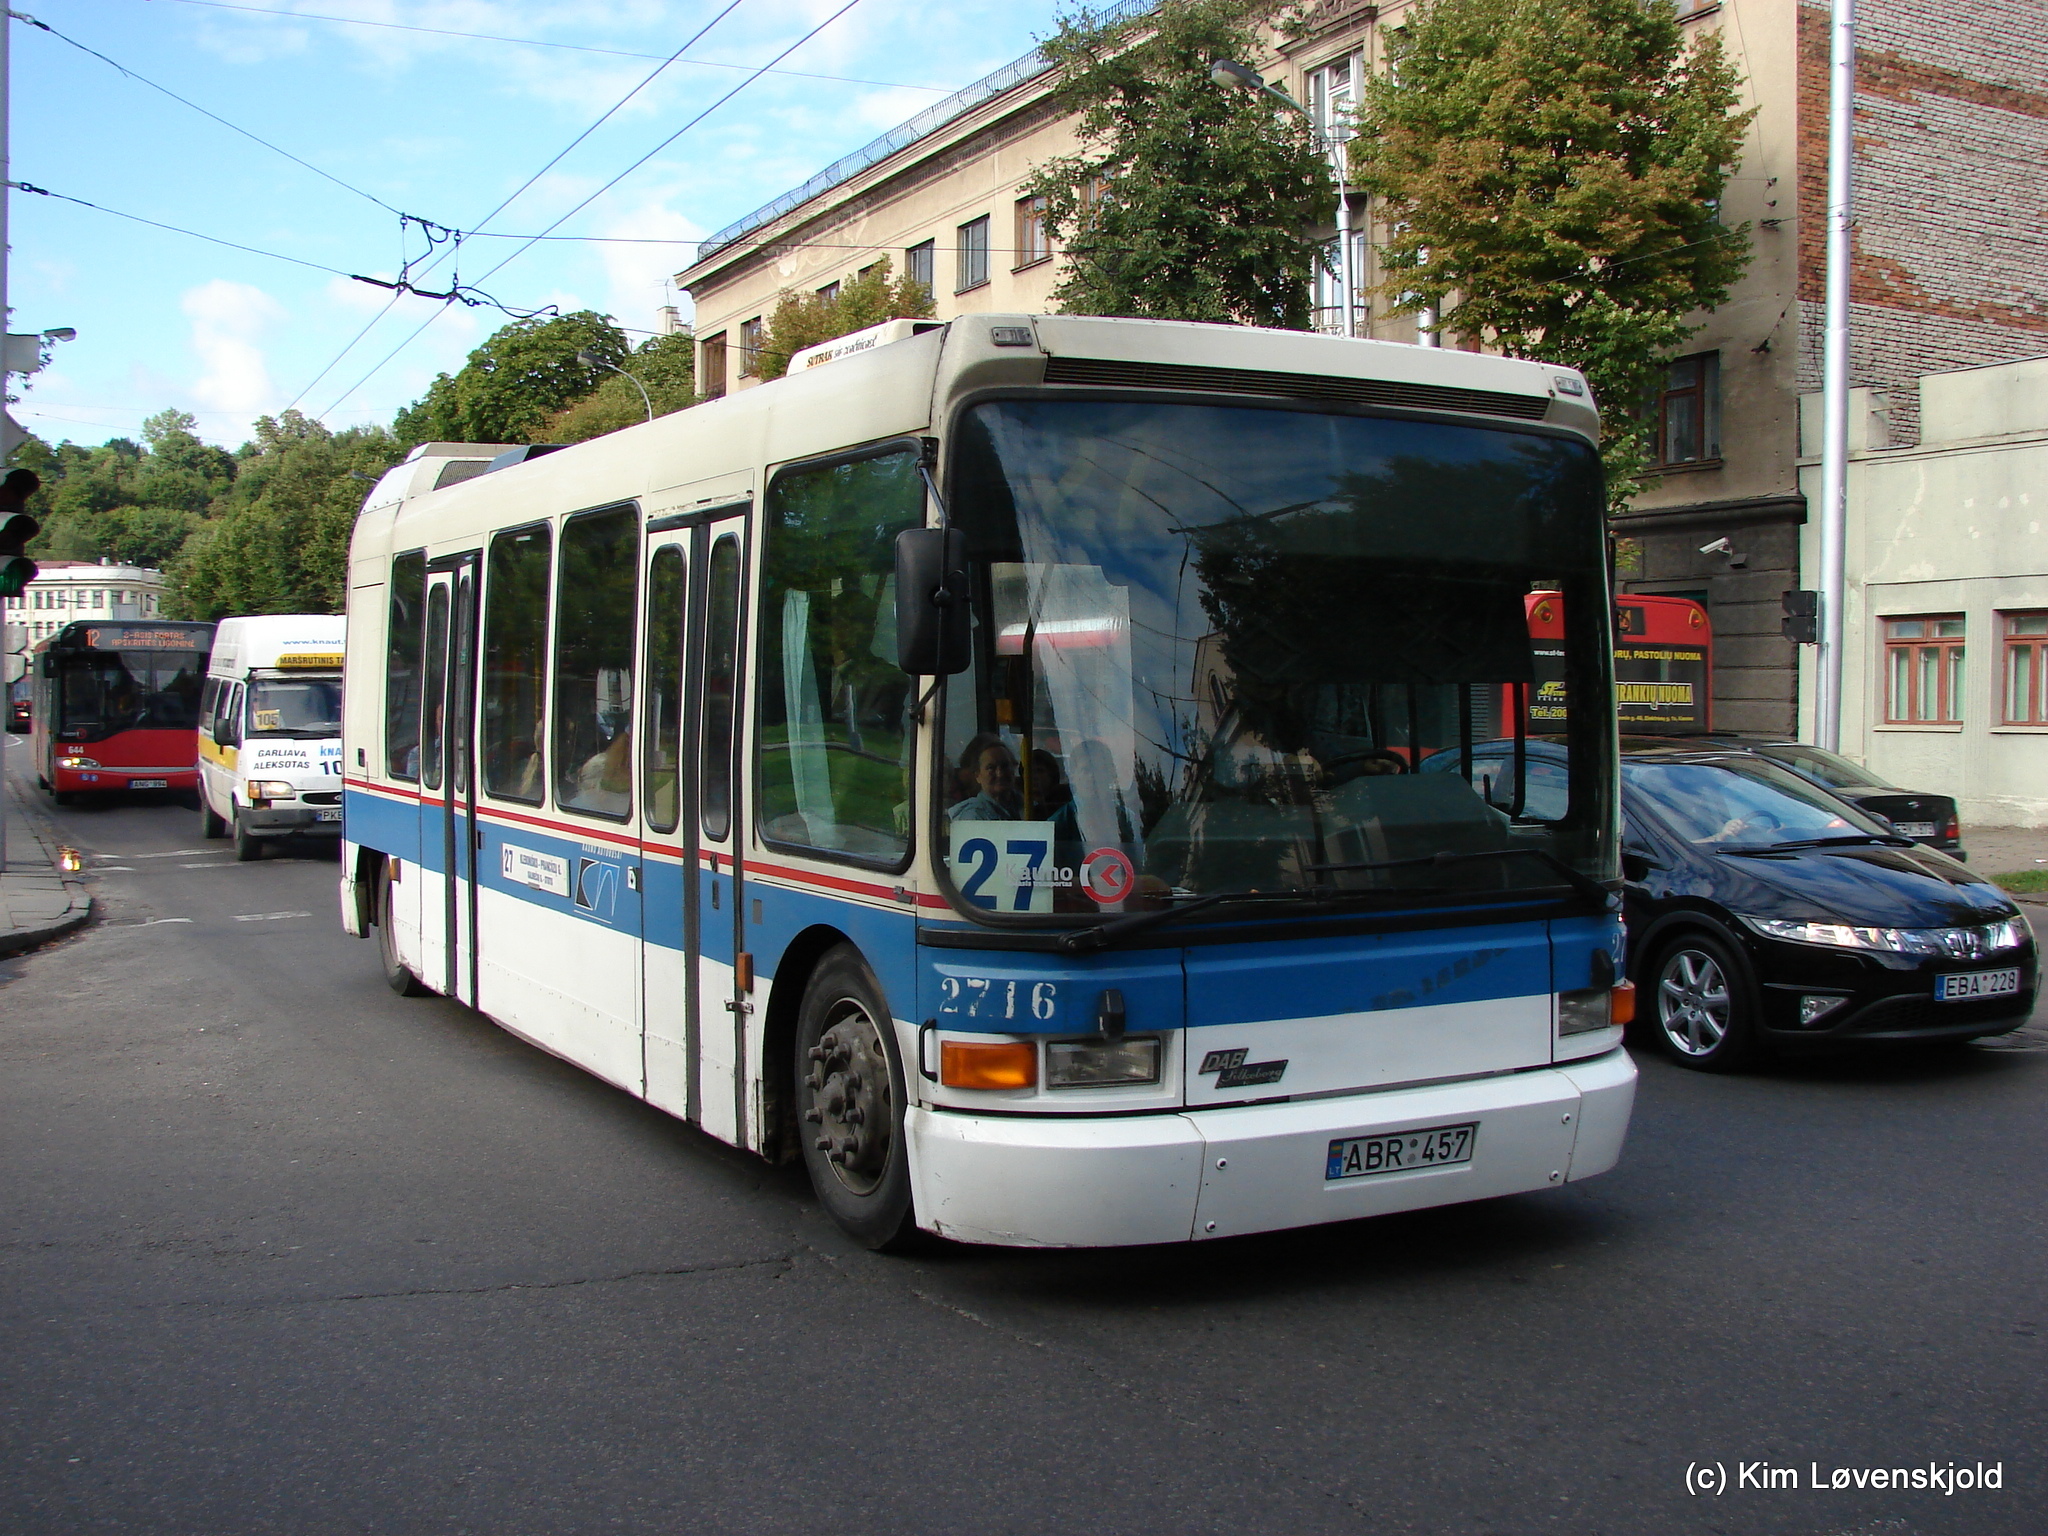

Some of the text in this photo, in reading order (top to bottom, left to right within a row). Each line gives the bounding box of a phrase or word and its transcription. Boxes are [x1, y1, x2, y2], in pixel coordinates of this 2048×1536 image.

[85, 629, 100, 647] 12
[1658, 685, 1692, 703] NUOMA
[256, 713, 279, 726] 105
[1531, 707, 1549, 718] Tel.
[68, 745, 85, 754] 644
[257, 749, 307, 758] GARLIAVA
[253, 760, 310, 771] ALEKSOTAS
[504, 848, 513, 874] 27
[958, 837, 1048, 911] 27
[1005, 863, 1074, 882] Kauno
[1946, 975, 1980, 996] EBA
[1990, 971, 2015, 993] 228
[939, 977, 1057, 1020] 2716
[1204, 1052, 1246, 1071] DAB
[1328, 1129, 1470, 1175] LT ABR 457
